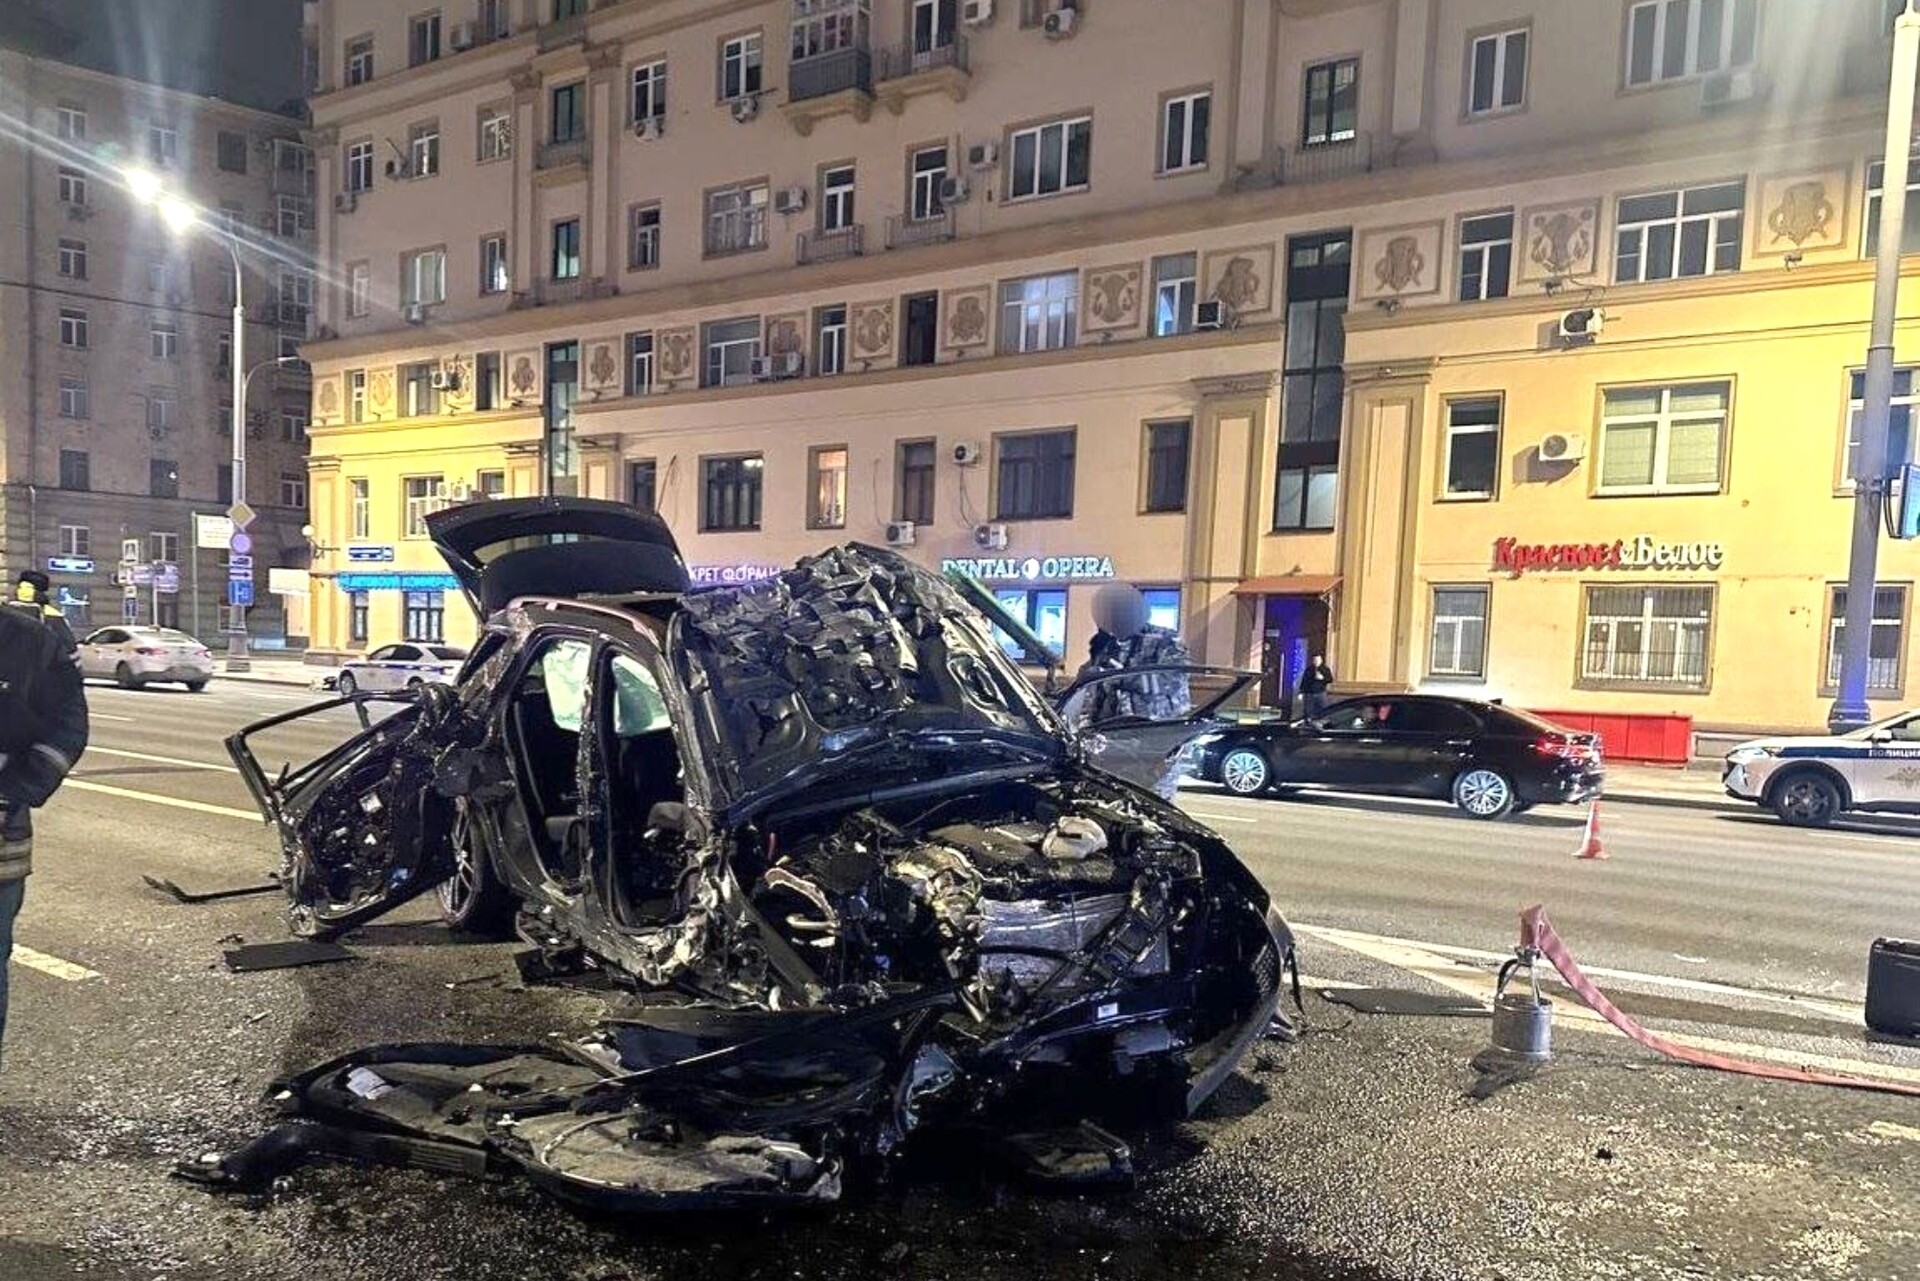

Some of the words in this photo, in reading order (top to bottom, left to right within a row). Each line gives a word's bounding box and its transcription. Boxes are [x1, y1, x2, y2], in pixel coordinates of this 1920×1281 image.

[688, 567, 719, 581] КРЕТ
[942, 559, 1020, 579] DENTAL
[1042, 557, 1114, 577] OPERA
[1868, 749, 1920, 758] ПОЛИЦИ
